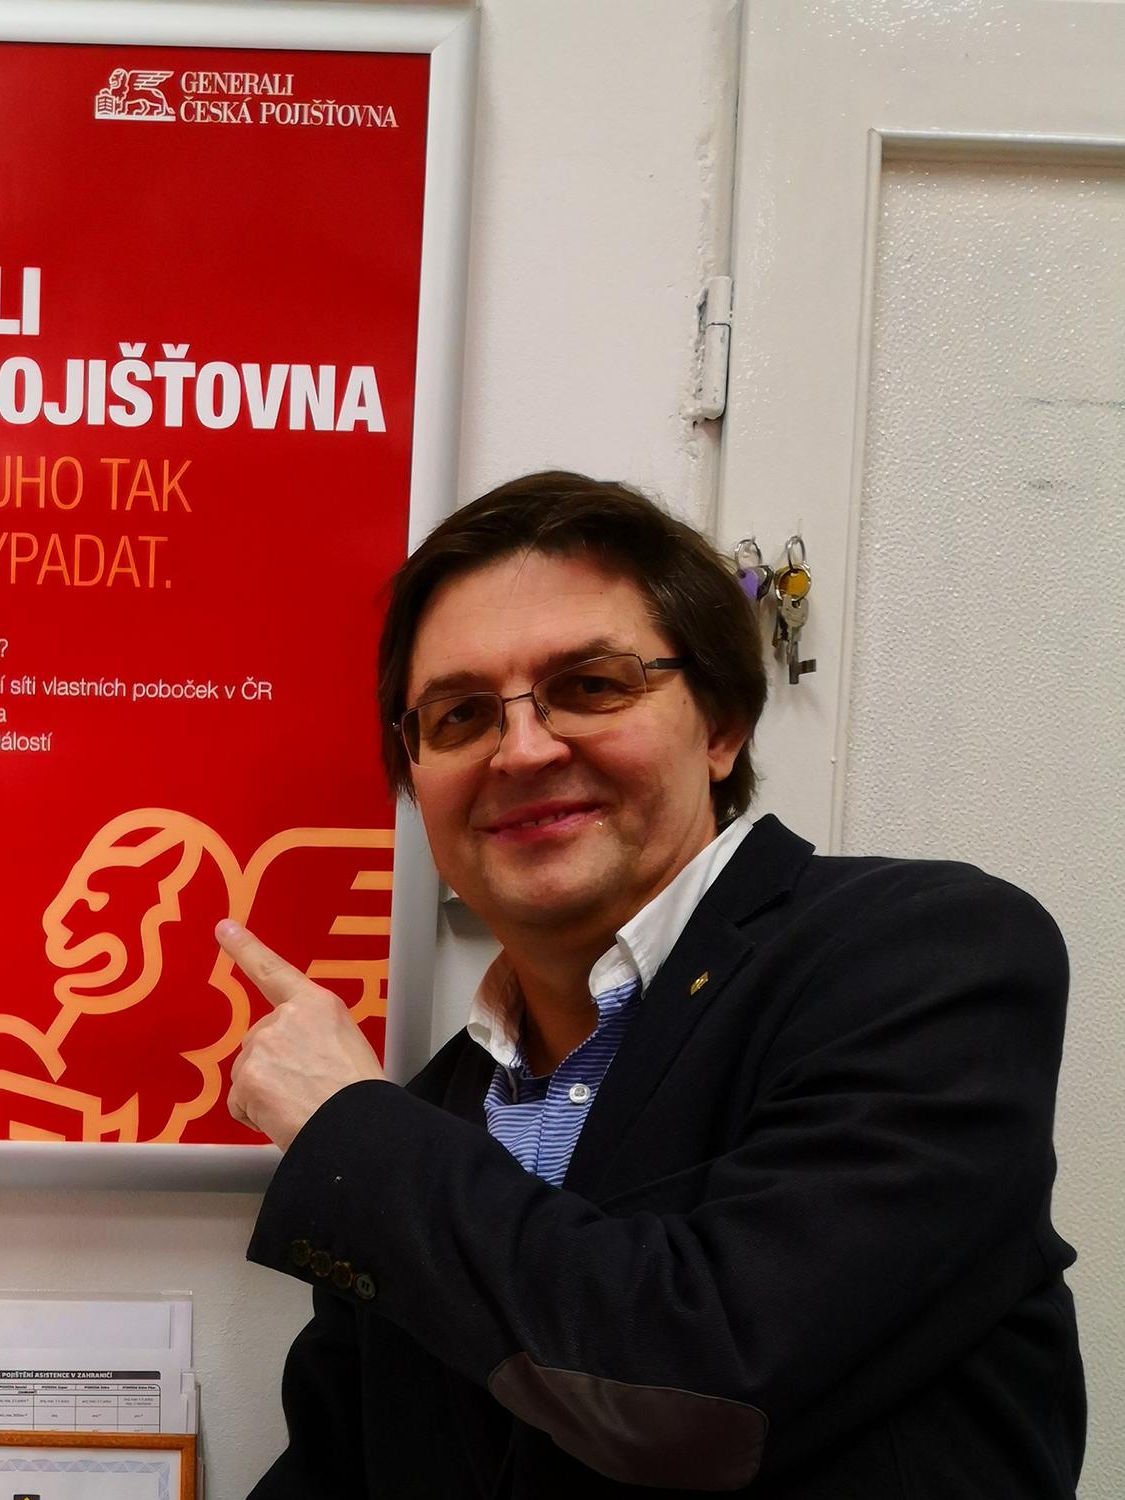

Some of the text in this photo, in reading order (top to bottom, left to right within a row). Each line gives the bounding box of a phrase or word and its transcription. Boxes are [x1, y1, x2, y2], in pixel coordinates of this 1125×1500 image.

[181, 72, 292, 96] GENERALI
[180, 96, 398, 128] ČESKÁ POJIŠŤOVNA
[101, 458, 192, 512] TAK
[10, 675, 36, 696] síti
[42, 677, 125, 697] vlastních
[133, 678, 218, 704] poboček
[224, 685, 235, 698] v
[242, 677, 272, 701] ČR
